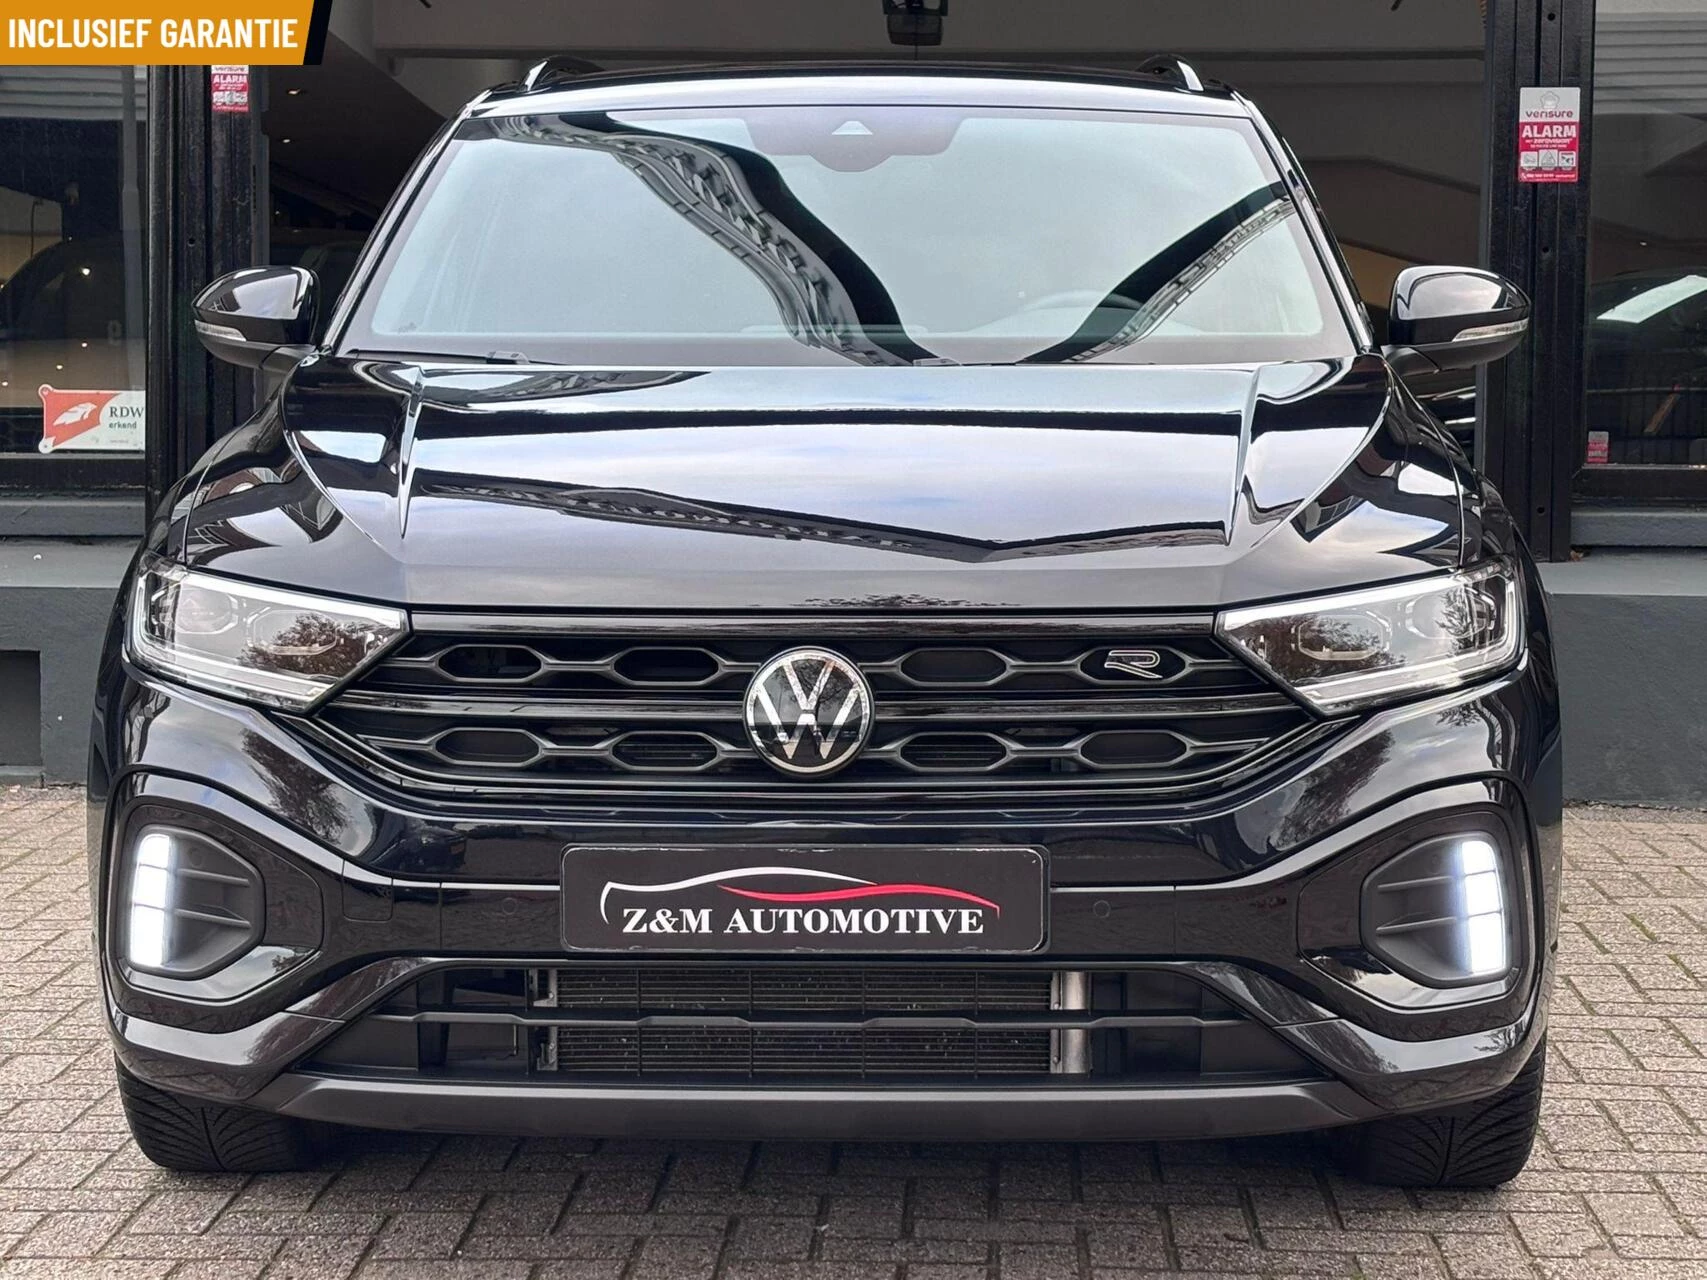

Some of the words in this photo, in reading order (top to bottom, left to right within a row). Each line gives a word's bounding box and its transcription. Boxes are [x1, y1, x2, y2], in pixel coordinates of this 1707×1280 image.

[1525, 110, 1573, 118] verisure
[1521, 125, 1576, 137] ALARM
[109, 406, 144, 418] RDW
[108, 421, 137, 429] erkend
[622, 908, 712, 934] Z&M
[724, 908, 984, 934] AUTOMOTIVE
